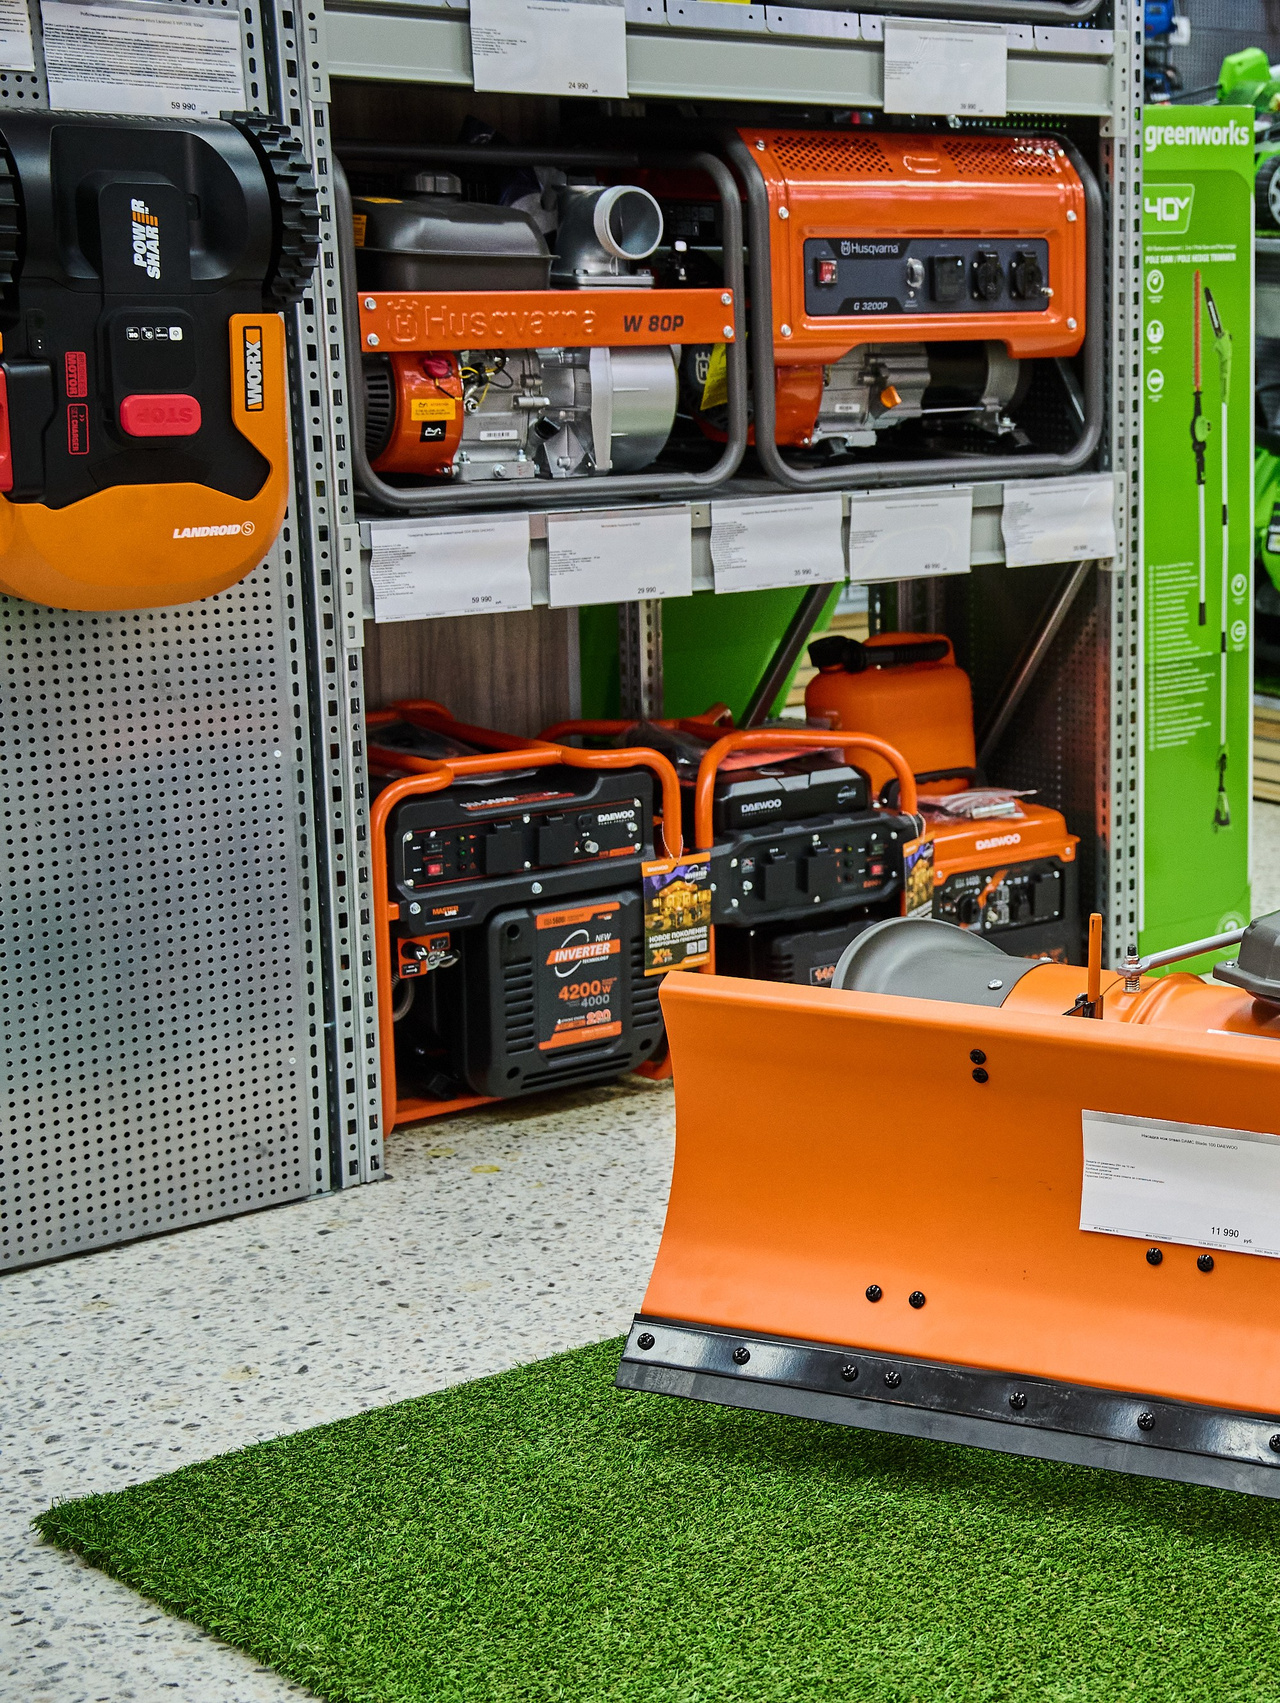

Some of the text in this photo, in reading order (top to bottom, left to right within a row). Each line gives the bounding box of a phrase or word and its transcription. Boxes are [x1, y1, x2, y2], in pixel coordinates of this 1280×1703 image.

[577, 82, 589, 90] 990
[171, 101, 196, 111] 59 990
[1144, 119, 1250, 152] greenworks
[131, 198, 148, 268] POWER
[145, 214, 161, 280] SHARE
[850, 243, 899, 255] Husqvarna
[853, 301, 888, 311] G 3200P
[622, 313, 684, 332] W 80P
[68, 354, 78, 395] MOTOR
[245, 340, 263, 406] WORX
[172, 524, 241, 539] LANDROID
[471, 595, 492, 604] 59 990
[741, 798, 782, 813] DAEWOO
[597, 809, 635, 822] DAEWOO
[975, 833, 1021, 851] DAEWOO
[647, 864, 669, 873] DAEWOO
[432, 905, 459, 916] MASTER
[595, 932, 612, 942] NEW
[649, 925, 708, 943] НОВОЕ ПОКОЛЕНИЕ
[554, 942, 611, 963] INVERTER
[582, 955, 610, 964] TECHNOLOGY
[558, 980, 612, 1001] 4200 W
[581, 994, 610, 1008] 4000
[1211, 1226, 1240, 1238] 11 990
